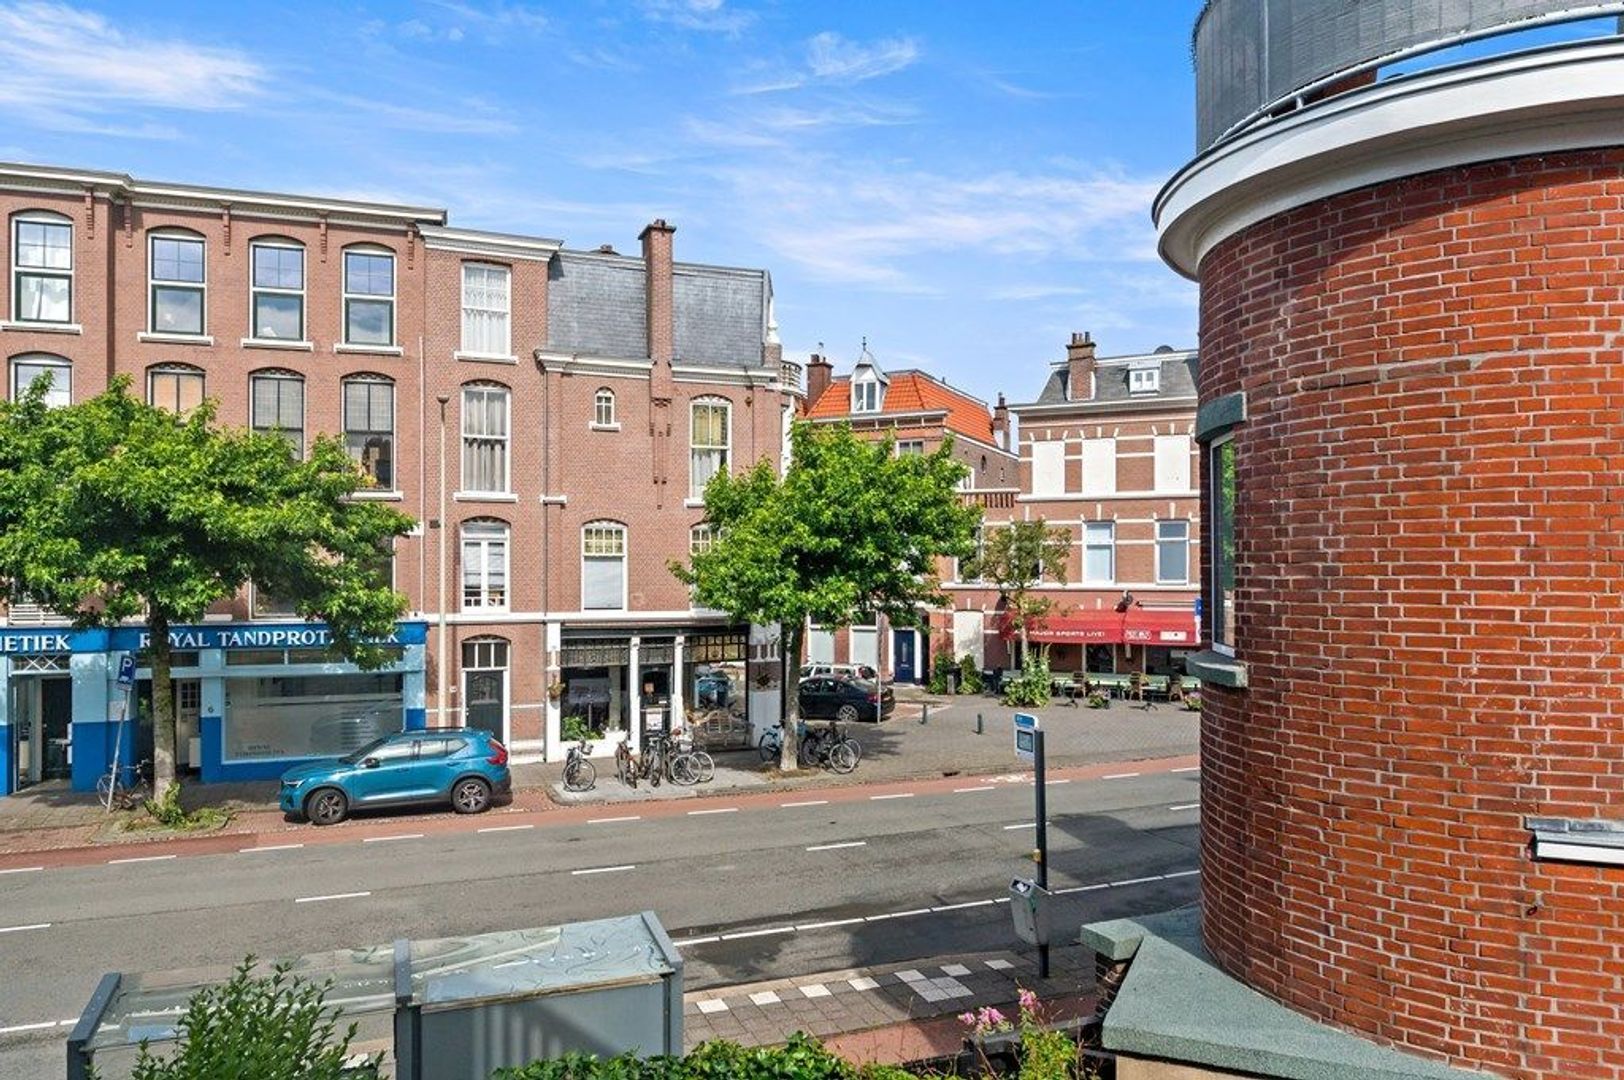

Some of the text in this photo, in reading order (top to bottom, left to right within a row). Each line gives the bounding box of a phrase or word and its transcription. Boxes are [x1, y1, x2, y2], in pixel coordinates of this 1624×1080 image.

[0, 634, 71, 652] ETIEK
[139, 632, 211, 648] RYAL
[122, 658, 132, 672] P
